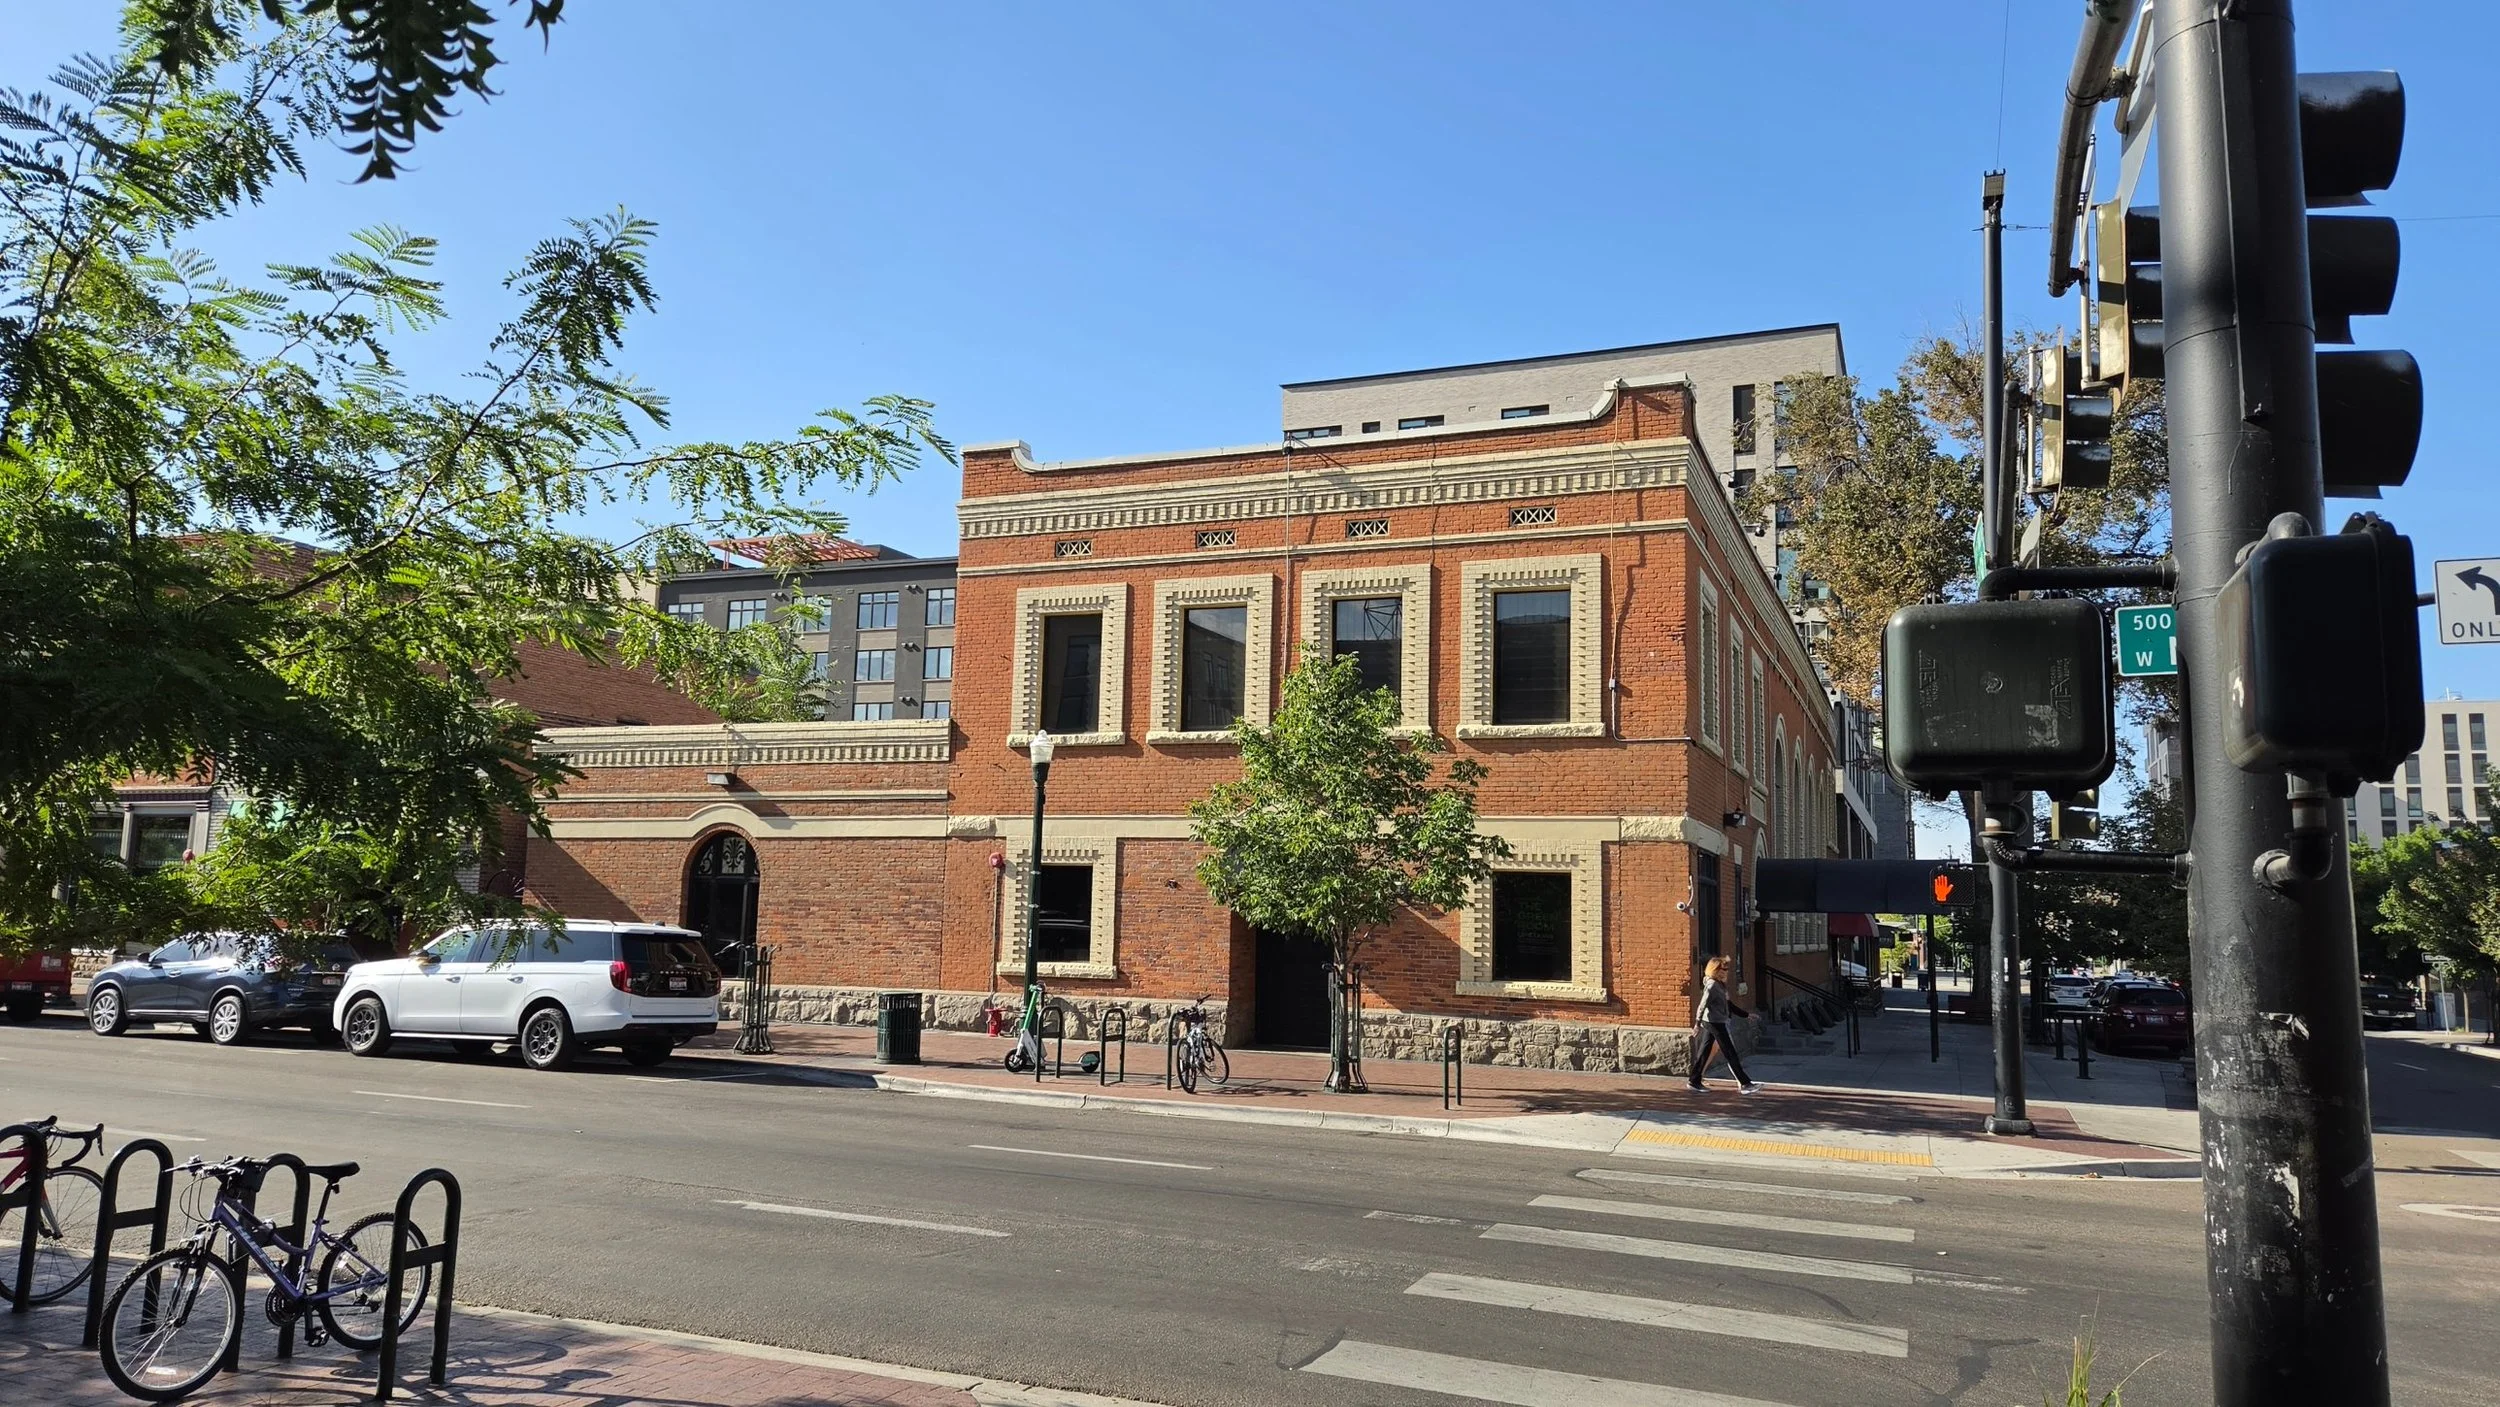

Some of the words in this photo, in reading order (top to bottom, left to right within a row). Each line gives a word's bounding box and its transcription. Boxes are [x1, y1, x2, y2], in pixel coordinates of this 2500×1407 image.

[2133, 613, 2172, 631] 500
[2452, 621, 2500, 638] ONL
[2135, 651, 2153, 667] W
